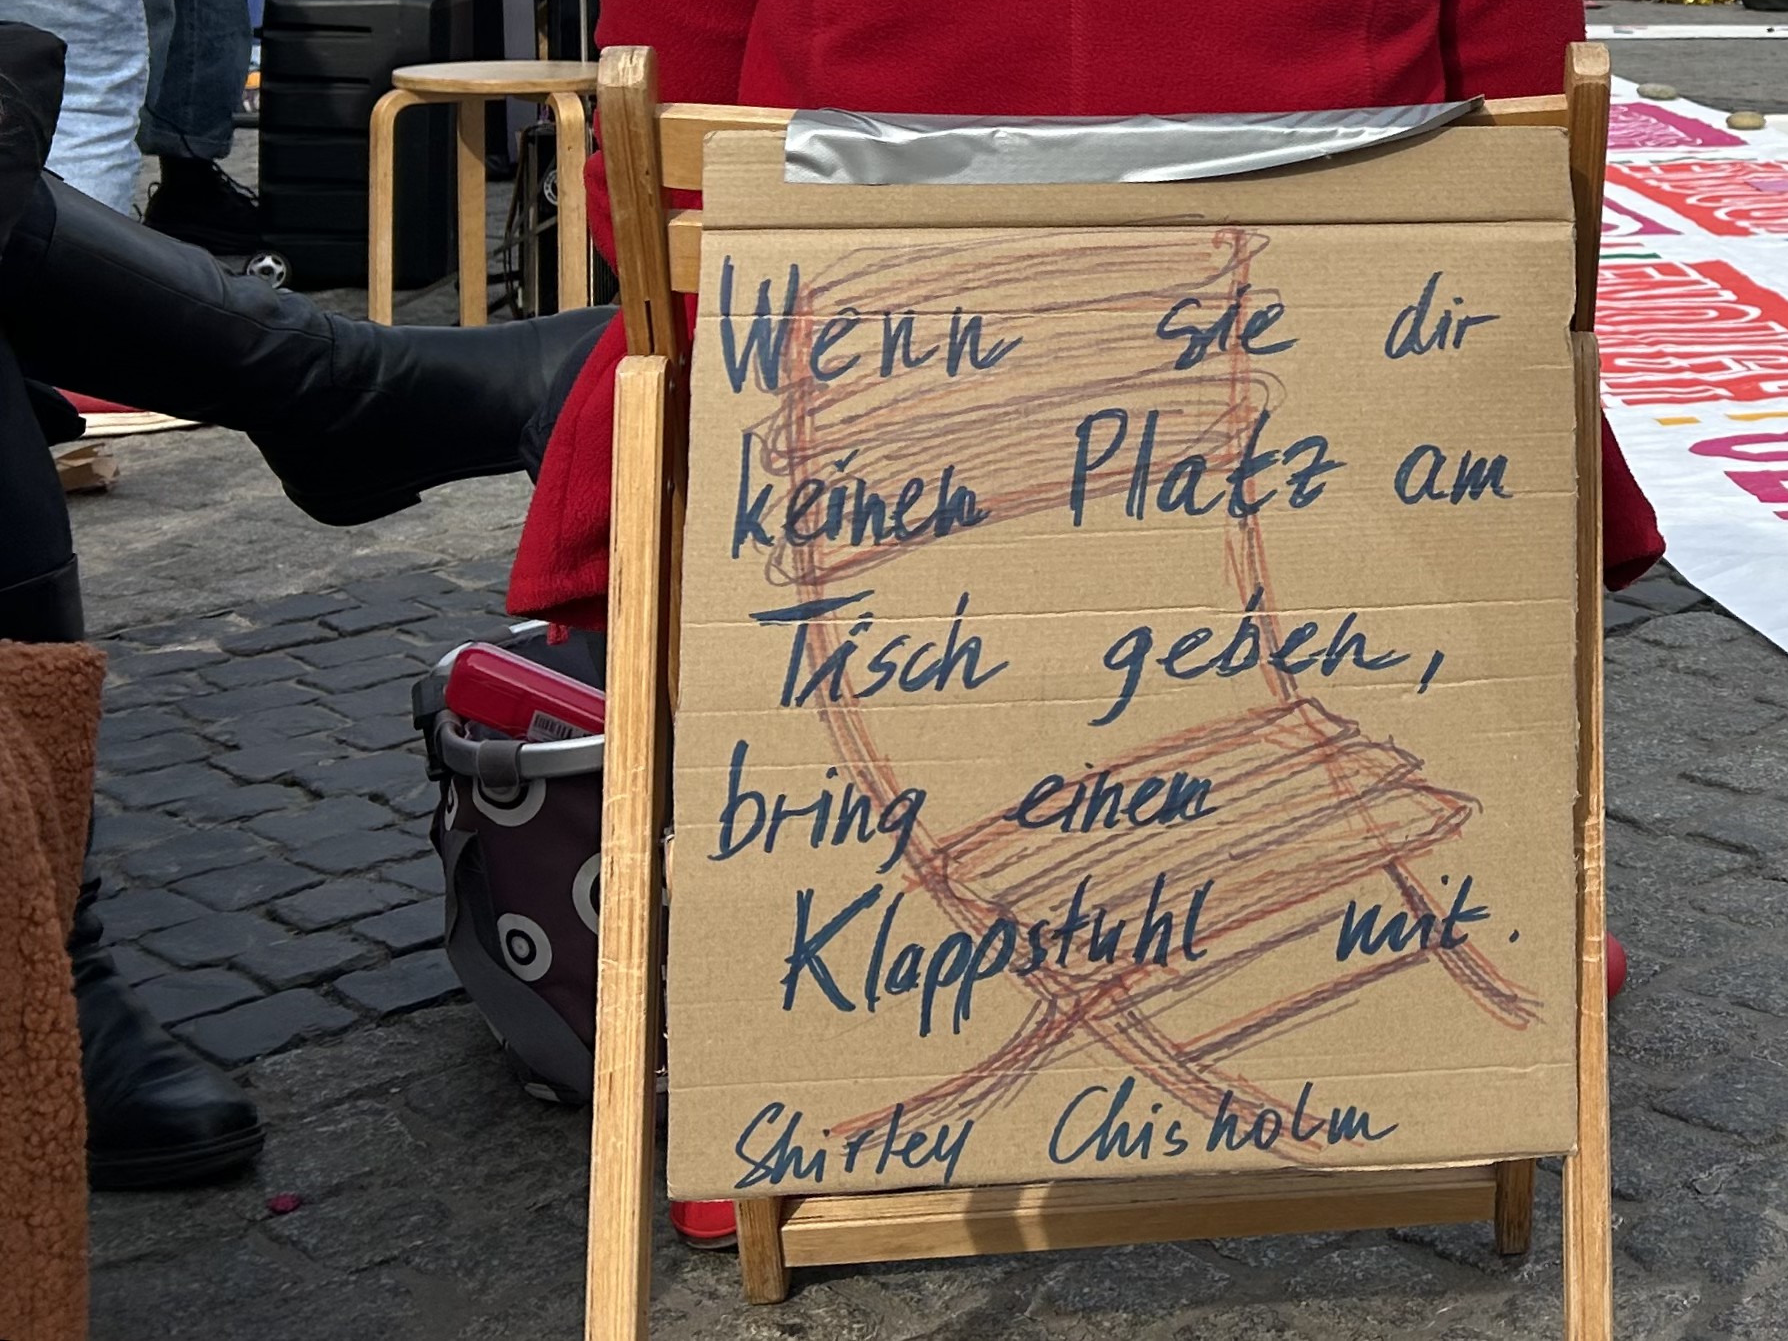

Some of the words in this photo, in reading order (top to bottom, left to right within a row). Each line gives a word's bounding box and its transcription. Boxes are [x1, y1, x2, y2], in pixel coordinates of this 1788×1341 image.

[720, 256, 1024, 395] Wenn
[1162, 284, 1301, 368] sie
[1385, 272, 1502, 359] dir
[1071, 408, 1345, 528] Platz
[1396, 445, 1512, 502] am
[750, 588, 1011, 706] Tisch
[1089, 586, 1447, 727] geben,
[707, 741, 928, 870] bring
[780, 874, 1214, 1037] Klappstuhl
[1048, 1076, 1400, 1167] Chisholm
